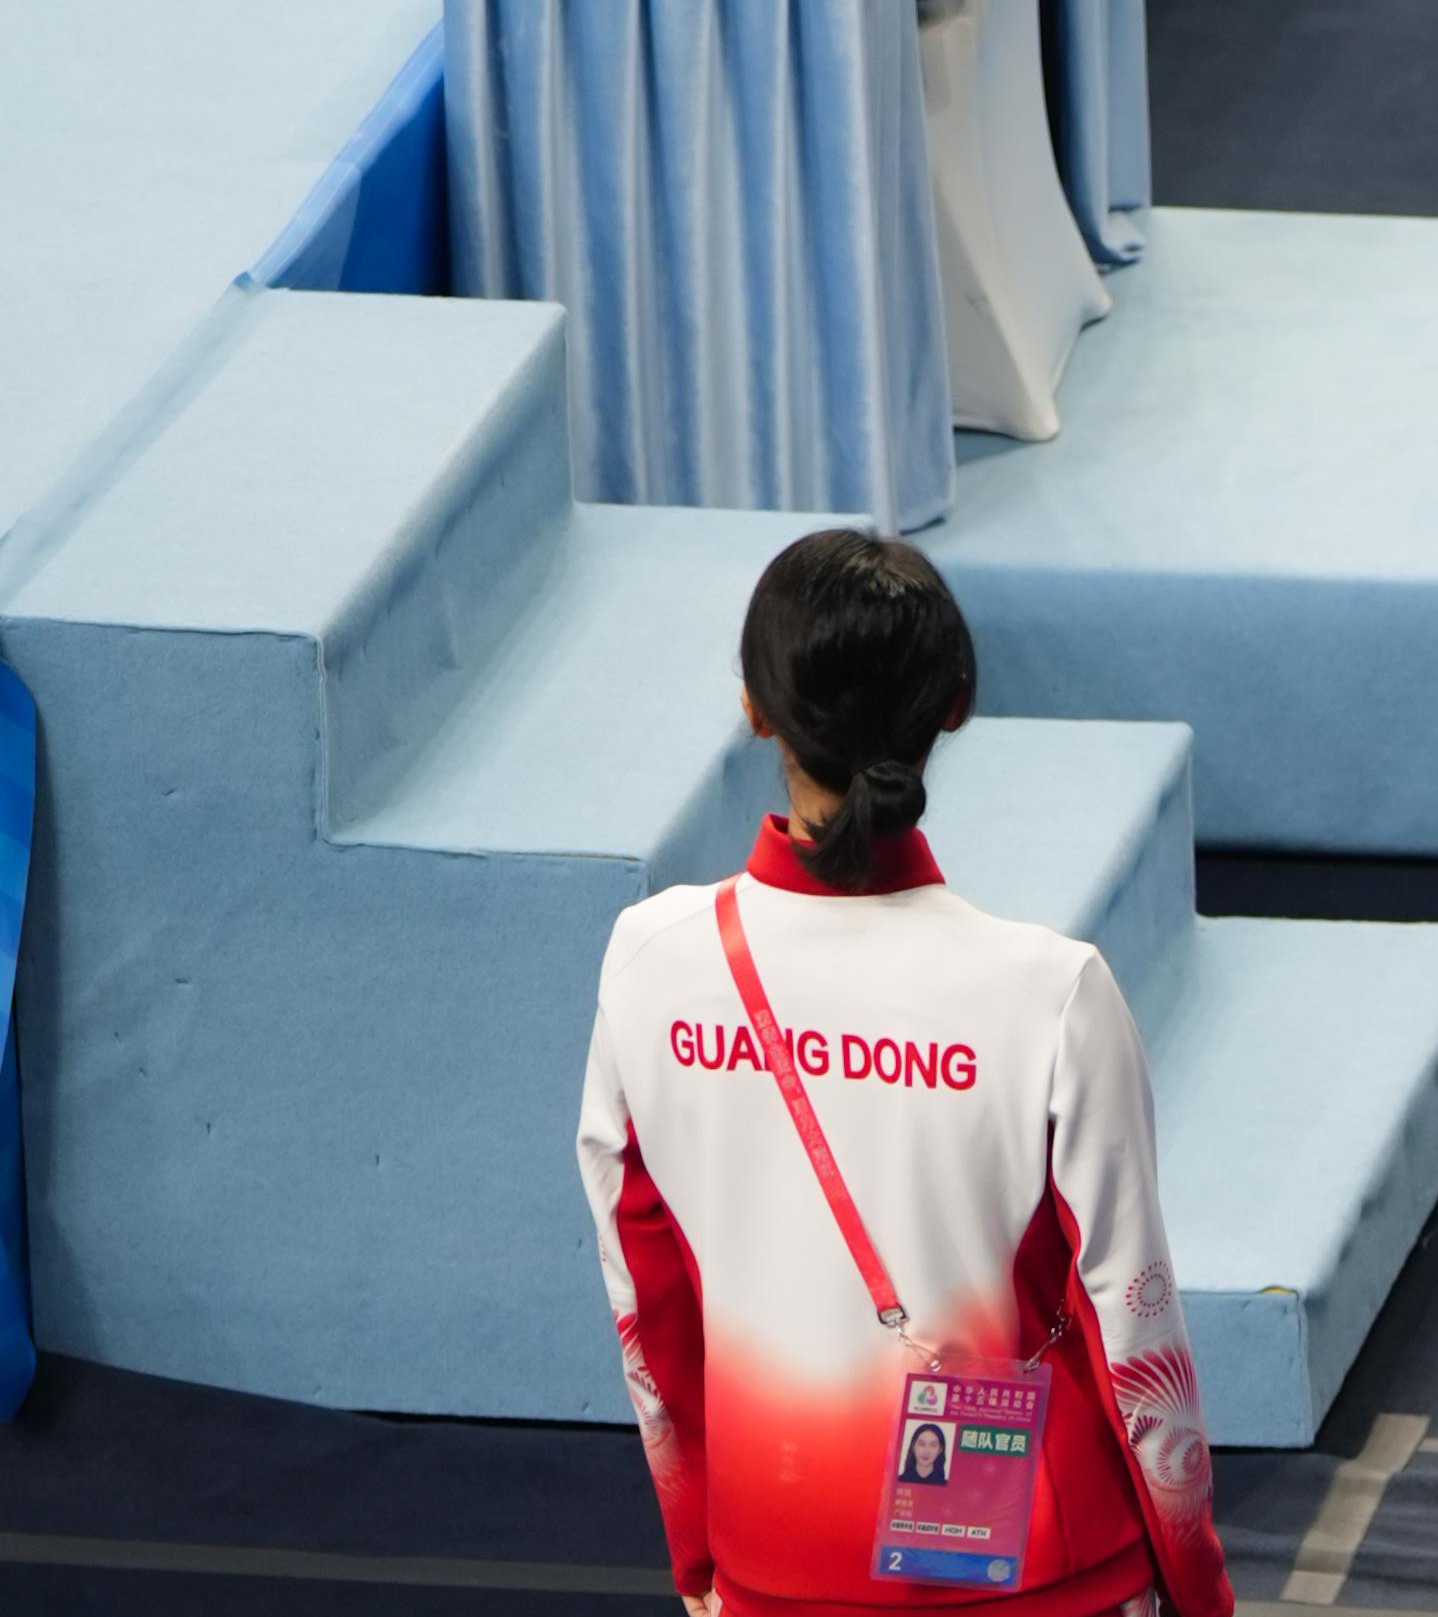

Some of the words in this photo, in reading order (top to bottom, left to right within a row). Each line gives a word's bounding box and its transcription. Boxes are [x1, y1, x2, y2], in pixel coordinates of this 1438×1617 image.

[841, 1034, 978, 1091] DONG
[960, 1430, 1028, 1453] 随队官员
[888, 1551, 903, 1570] 2
